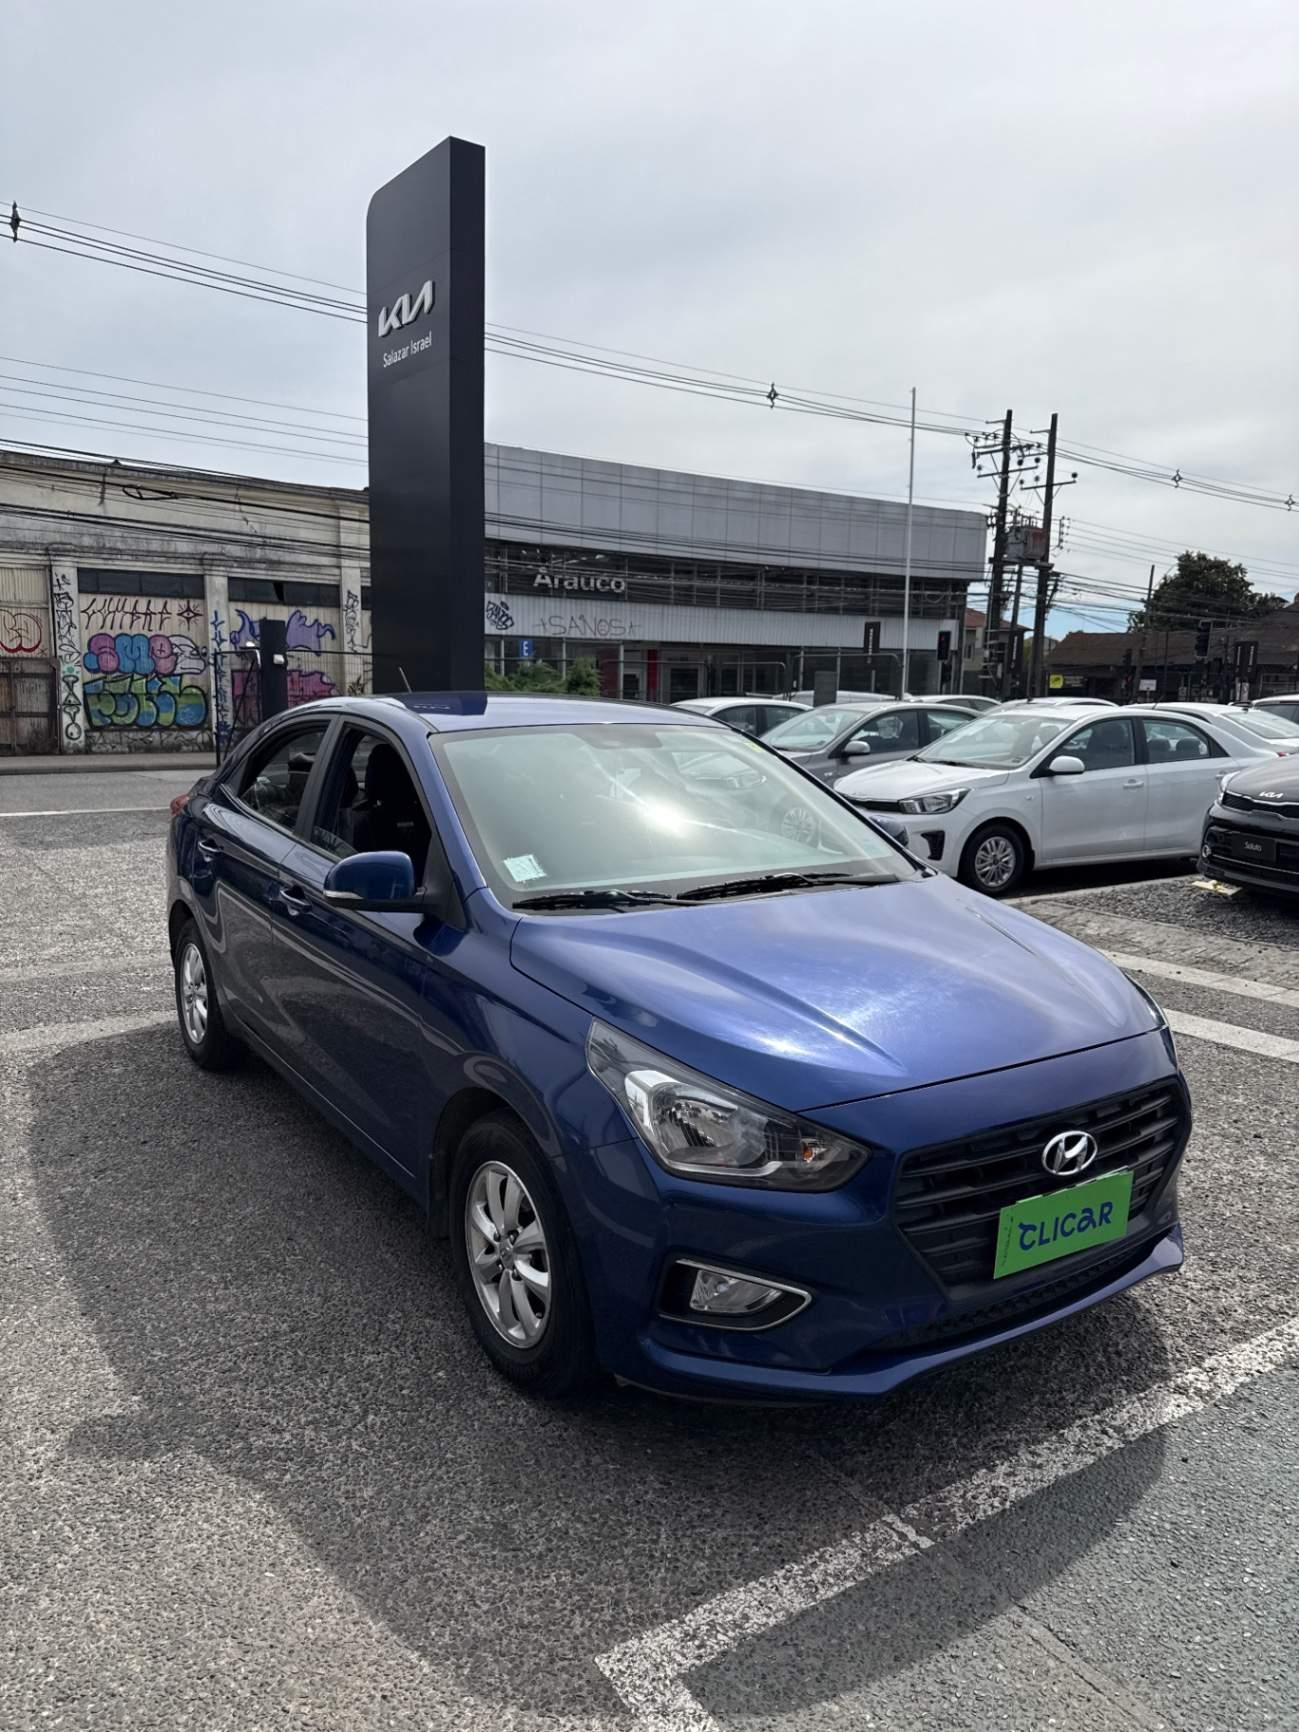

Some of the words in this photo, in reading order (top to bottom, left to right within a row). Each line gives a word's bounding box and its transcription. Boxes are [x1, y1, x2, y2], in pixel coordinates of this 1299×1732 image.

[378, 280, 433, 337] KIA
[383, 346, 410, 368] Salazar
[410, 330, 432, 355] Israel
[533, 574, 625, 593] Arauco
